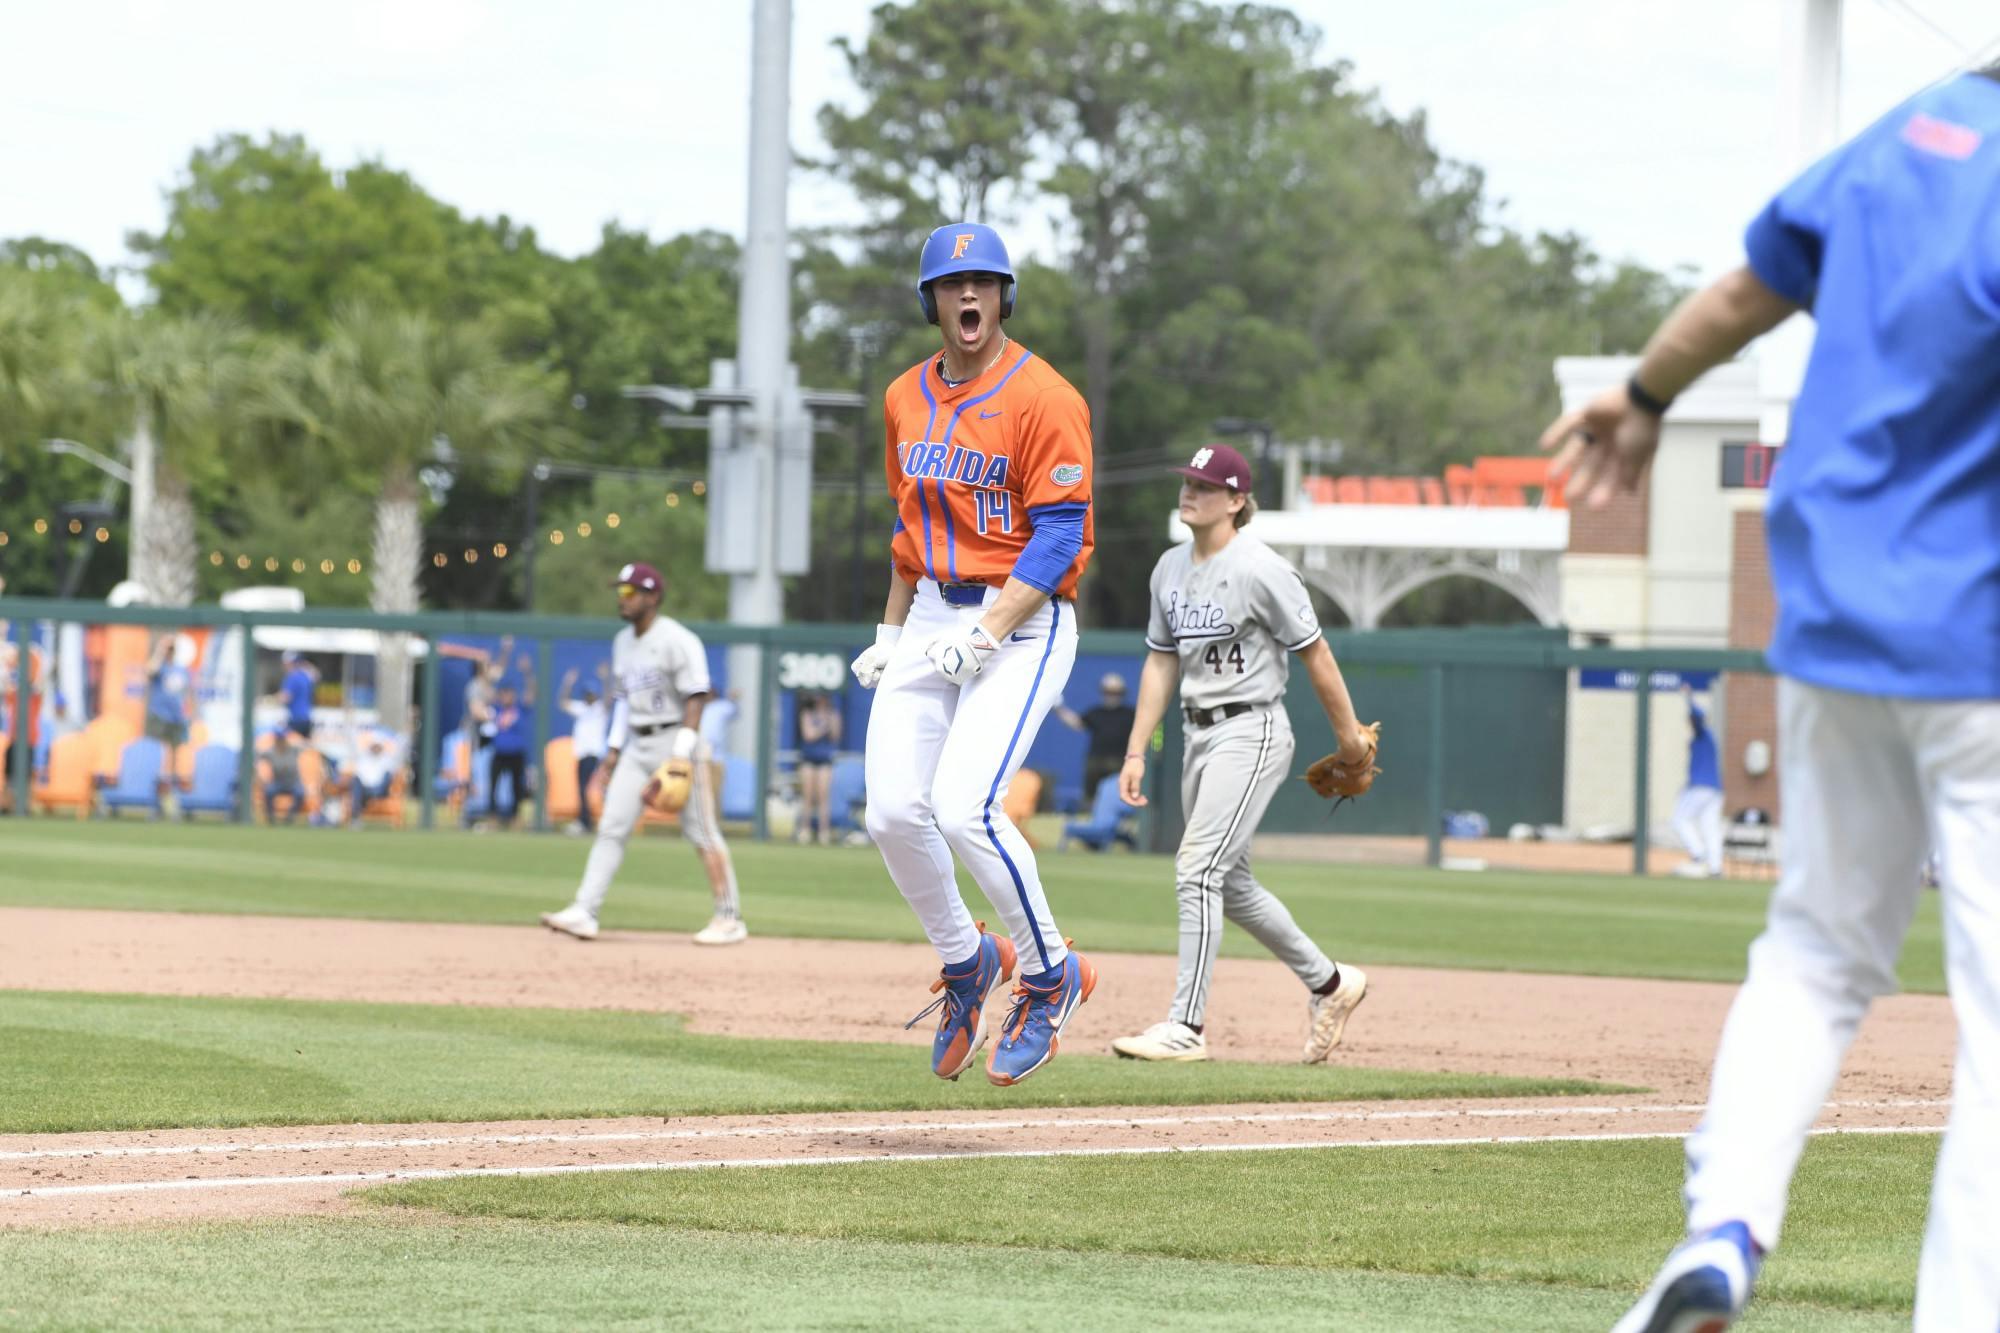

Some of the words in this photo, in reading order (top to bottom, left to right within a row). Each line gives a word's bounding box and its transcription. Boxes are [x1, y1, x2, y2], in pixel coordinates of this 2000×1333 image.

[951, 234, 974, 259] F
[897, 442, 1009, 487] ORIDA
[974, 490, 1011, 535] 14
[1168, 591, 1228, 634] State
[1205, 643, 1245, 675] 44
